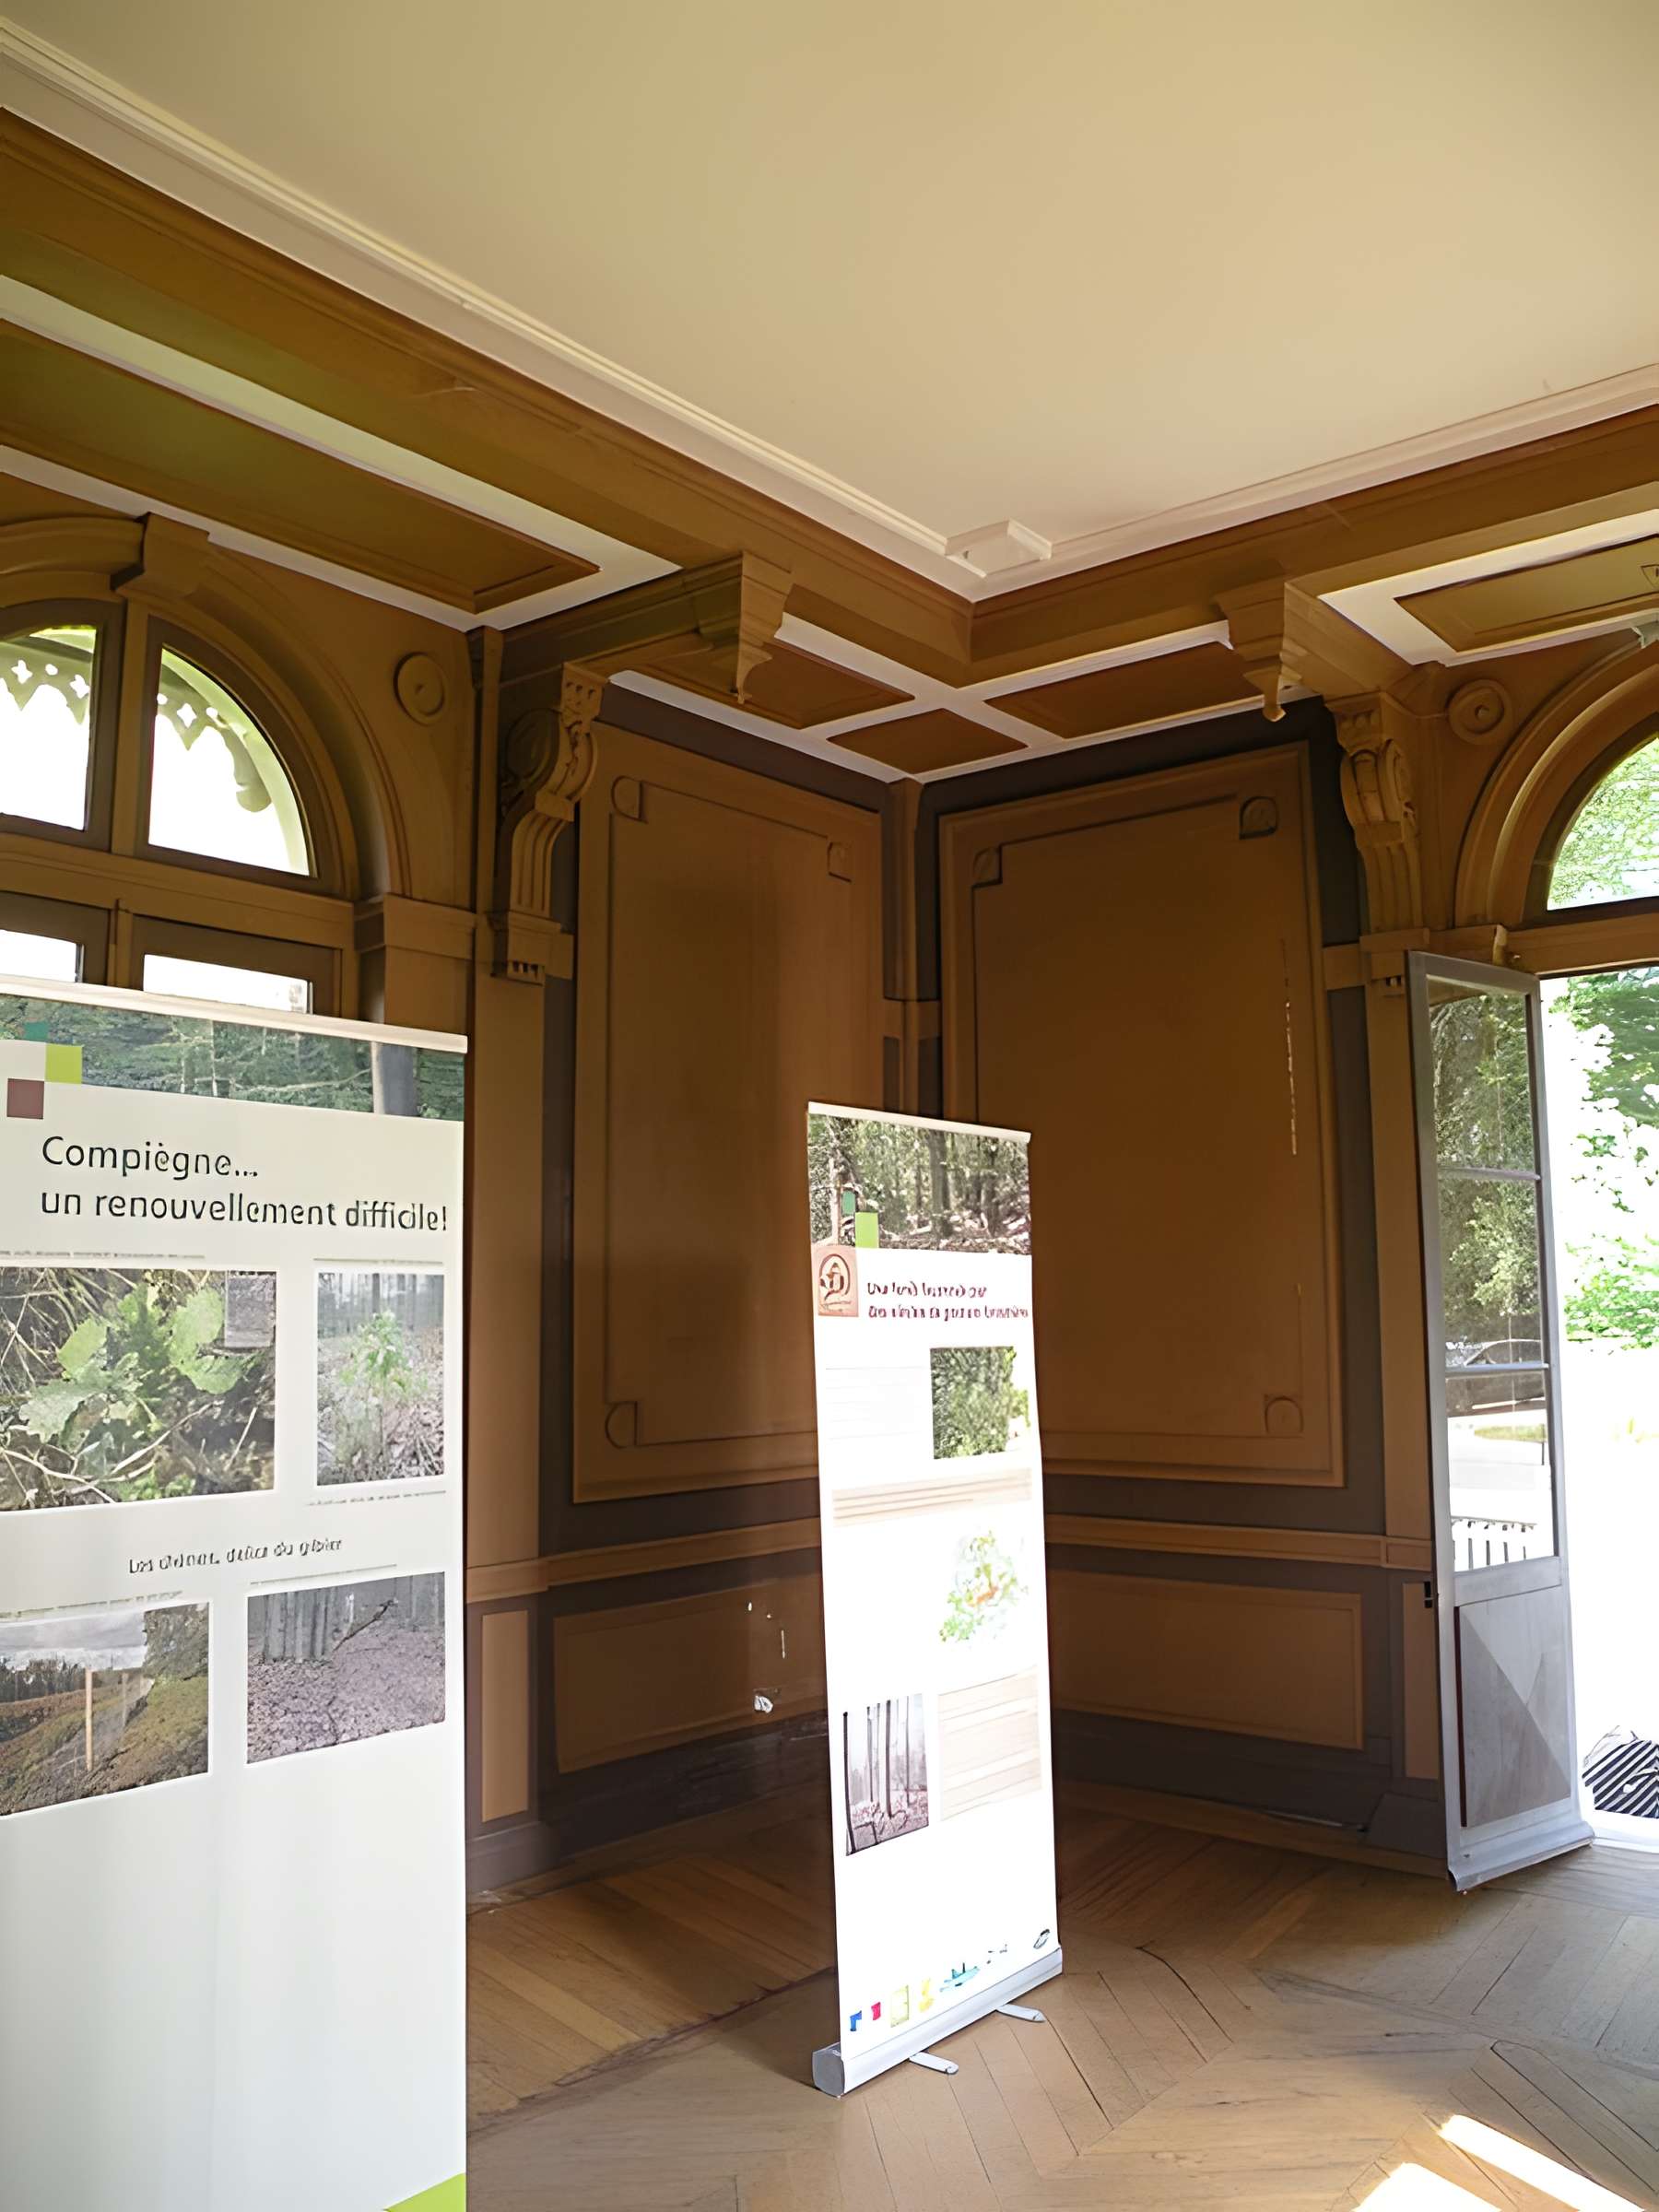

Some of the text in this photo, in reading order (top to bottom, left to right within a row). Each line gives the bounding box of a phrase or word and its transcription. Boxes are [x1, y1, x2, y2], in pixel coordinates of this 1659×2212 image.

[41, 1135, 258, 1181] Compiègne...
[41, 1192, 447, 1231] un renouvellement difficile!
